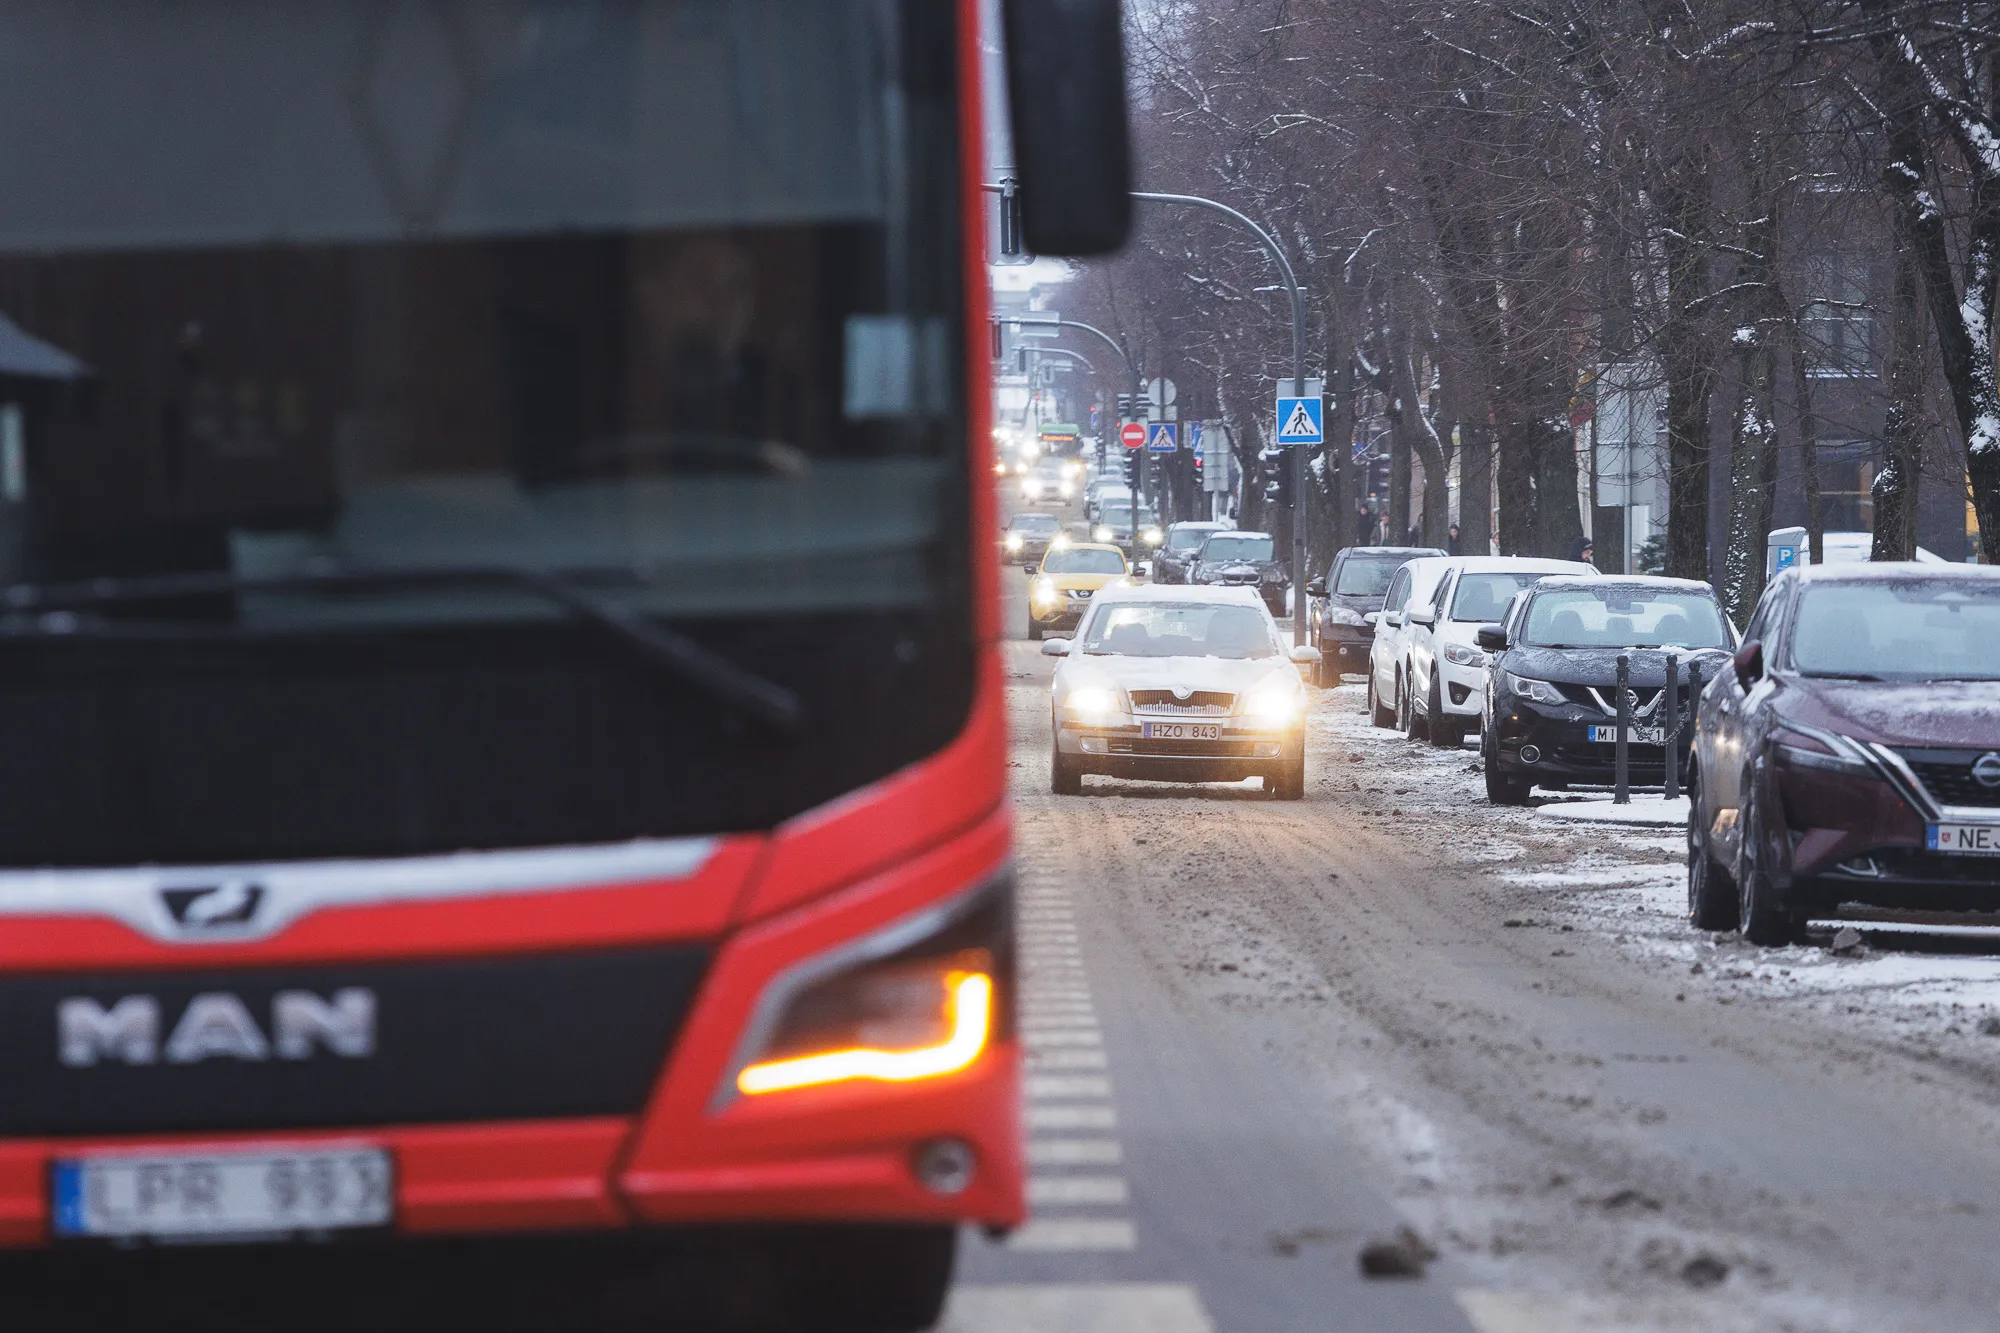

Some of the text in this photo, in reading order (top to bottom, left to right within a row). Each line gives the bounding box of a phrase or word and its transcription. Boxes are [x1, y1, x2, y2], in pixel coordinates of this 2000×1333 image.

[1780, 549, 1791, 562] P
[1153, 725, 1217, 738] HZO 843
[1597, 728, 1615, 741] MI
[57, 987, 377, 1067] MAN
